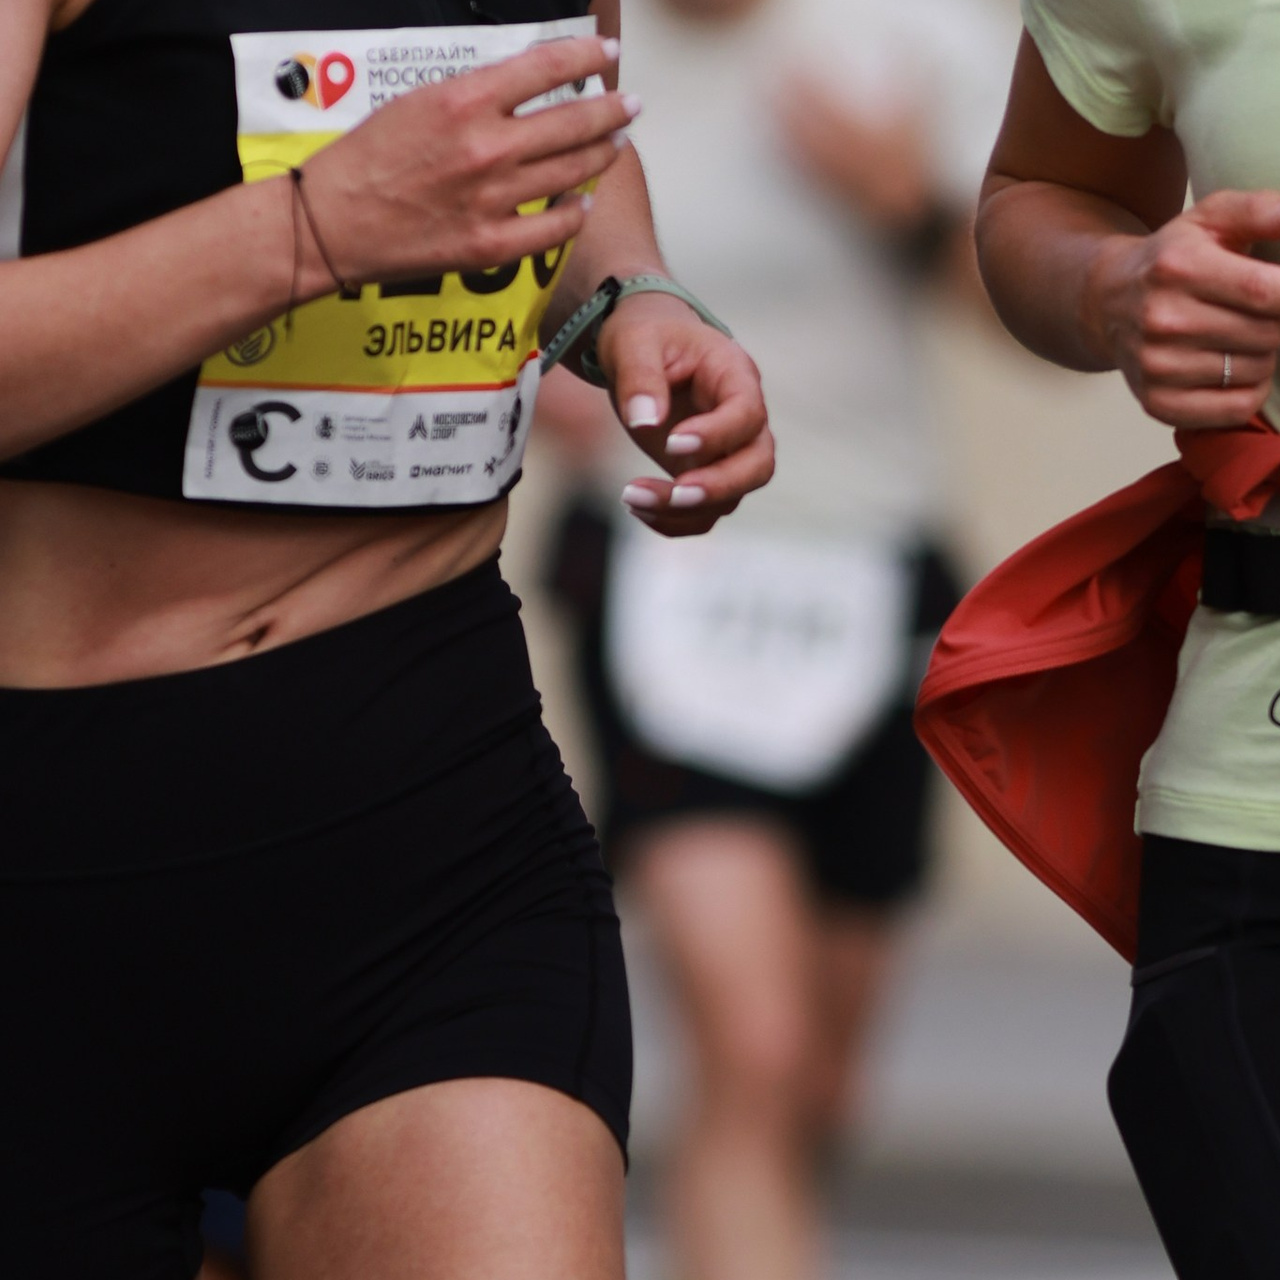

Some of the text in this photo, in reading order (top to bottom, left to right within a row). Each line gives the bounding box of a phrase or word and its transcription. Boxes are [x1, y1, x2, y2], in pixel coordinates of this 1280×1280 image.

[366, 42, 475, 64] СБЕРПРАЙМ
[368, 65, 473, 87] МОСКОВ
[363, 319, 516, 357] ЭЛЬВИРА
[432, 410, 488, 425] МОСКОВСКИЙ
[237, 401, 302, 482] C
